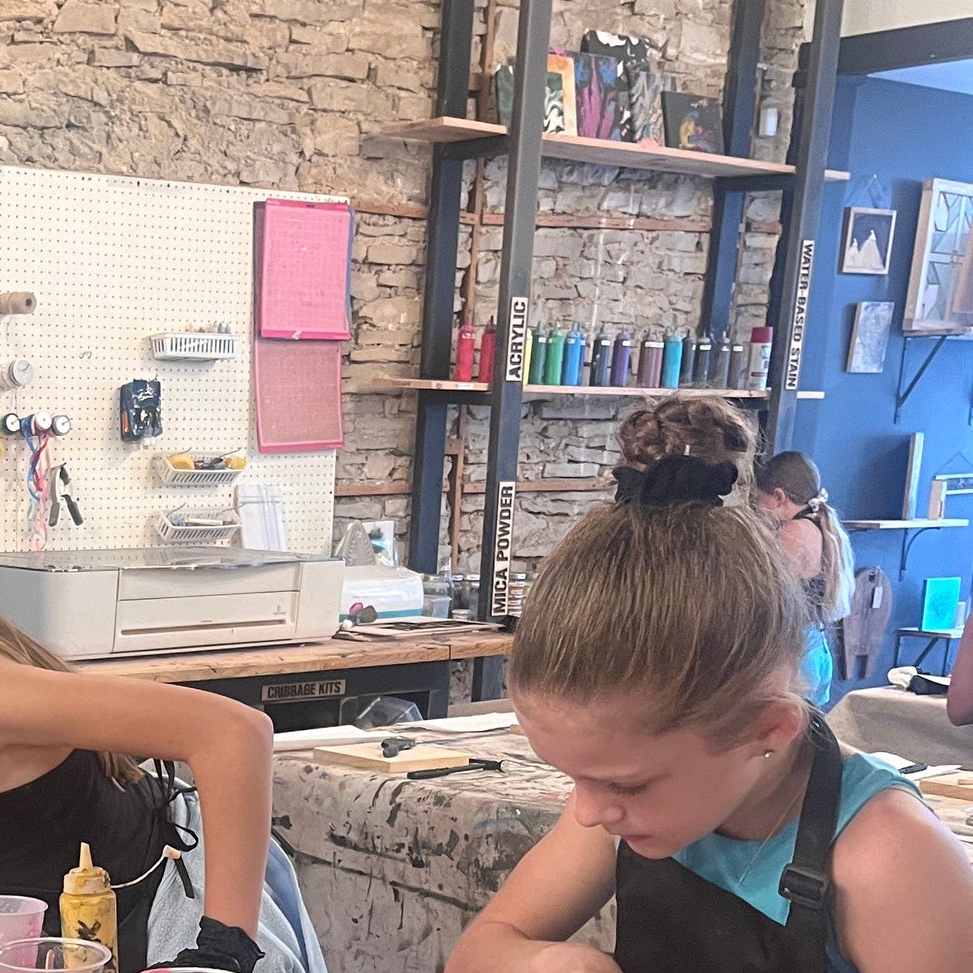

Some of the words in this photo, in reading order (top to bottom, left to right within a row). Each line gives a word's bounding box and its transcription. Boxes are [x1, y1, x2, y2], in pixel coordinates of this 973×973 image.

[793, 243, 814, 342] WATER-BASED
[508, 301, 526, 379] ACRYLIC
[787, 347, 802, 389] STAIN
[496, 486, 513, 562] POWDER
[493, 567, 508, 613] MICA
[268, 683, 316, 698] CRIBBAGE
[318, 681, 341, 695] KITS
